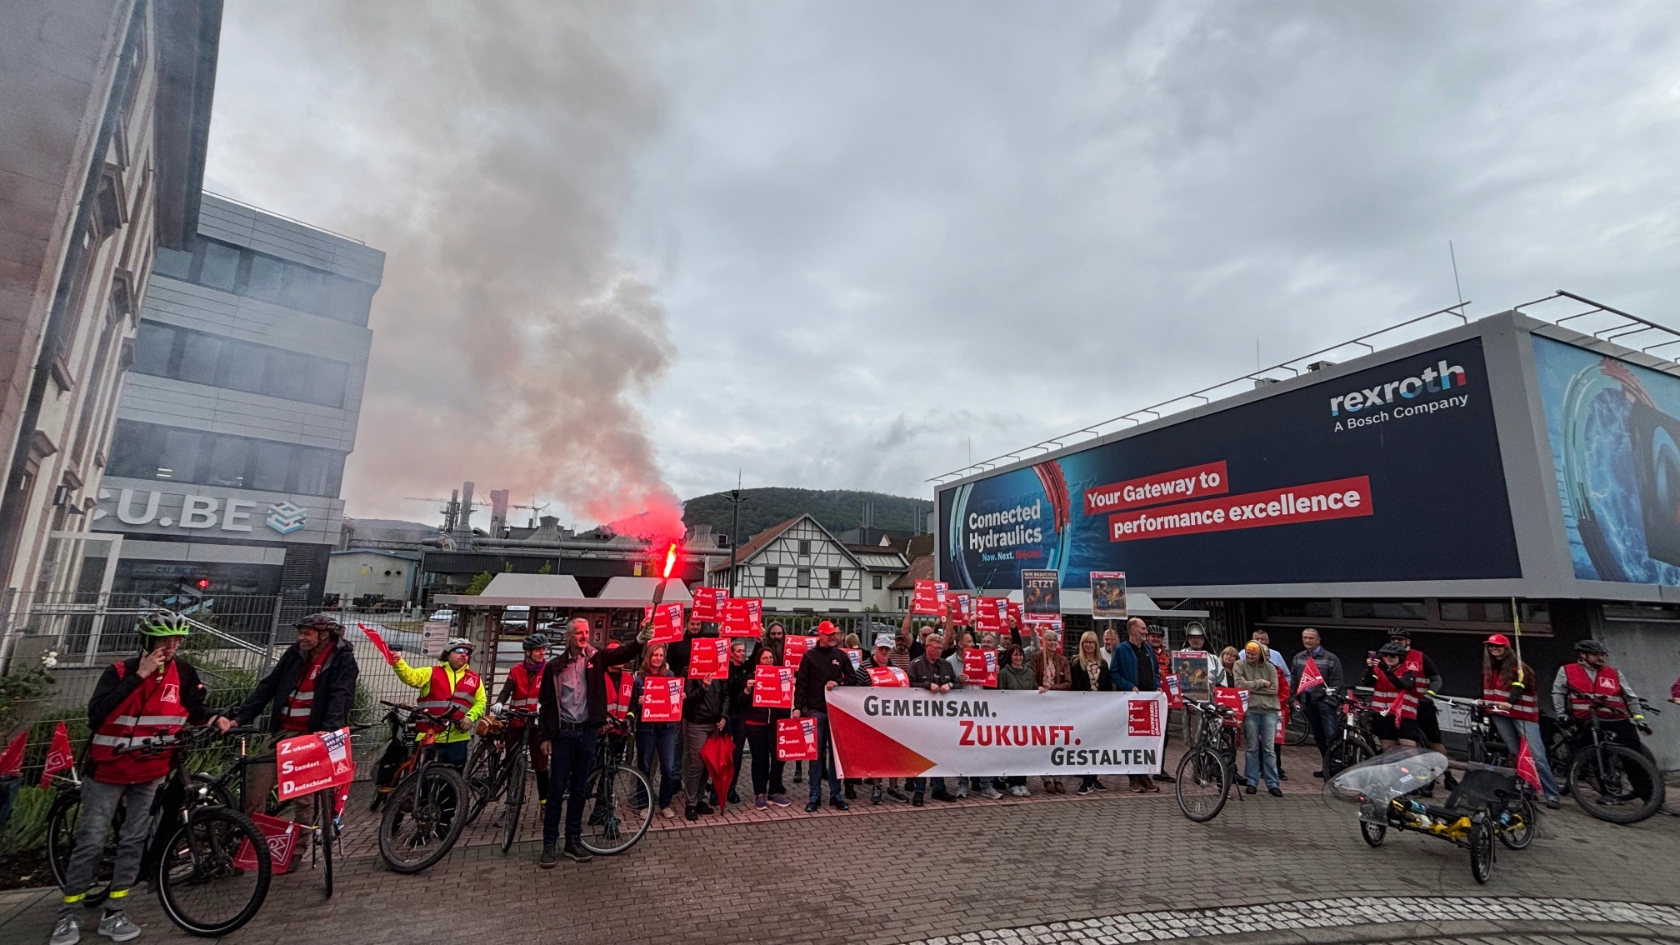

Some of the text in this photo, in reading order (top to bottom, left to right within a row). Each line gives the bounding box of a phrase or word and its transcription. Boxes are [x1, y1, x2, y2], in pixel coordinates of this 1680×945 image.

[1330, 360, 1466, 416] rexroth
[1334, 394, 1468, 432] A Bosch Company
[1088, 472, 1220, 508] Your Gateway to
[969, 499, 1040, 529] Connected
[1114, 490, 1360, 538] performance excellence
[970, 524, 1042, 553] Hydraulics
[982, 553, 997, 562] Now.
[998, 552, 1014, 560] Next.
[596, 632, 600, 642] 3
[864, 695, 997, 718] GEMEINSAM.
[959, 720, 1081, 746] ZUKUNFT.
[281, 742, 315, 754] Zukunft
[1051, 748, 1156, 766] GESTALTEN
[282, 761, 319, 774] Standort
[283, 776, 332, 794] Deutschland
